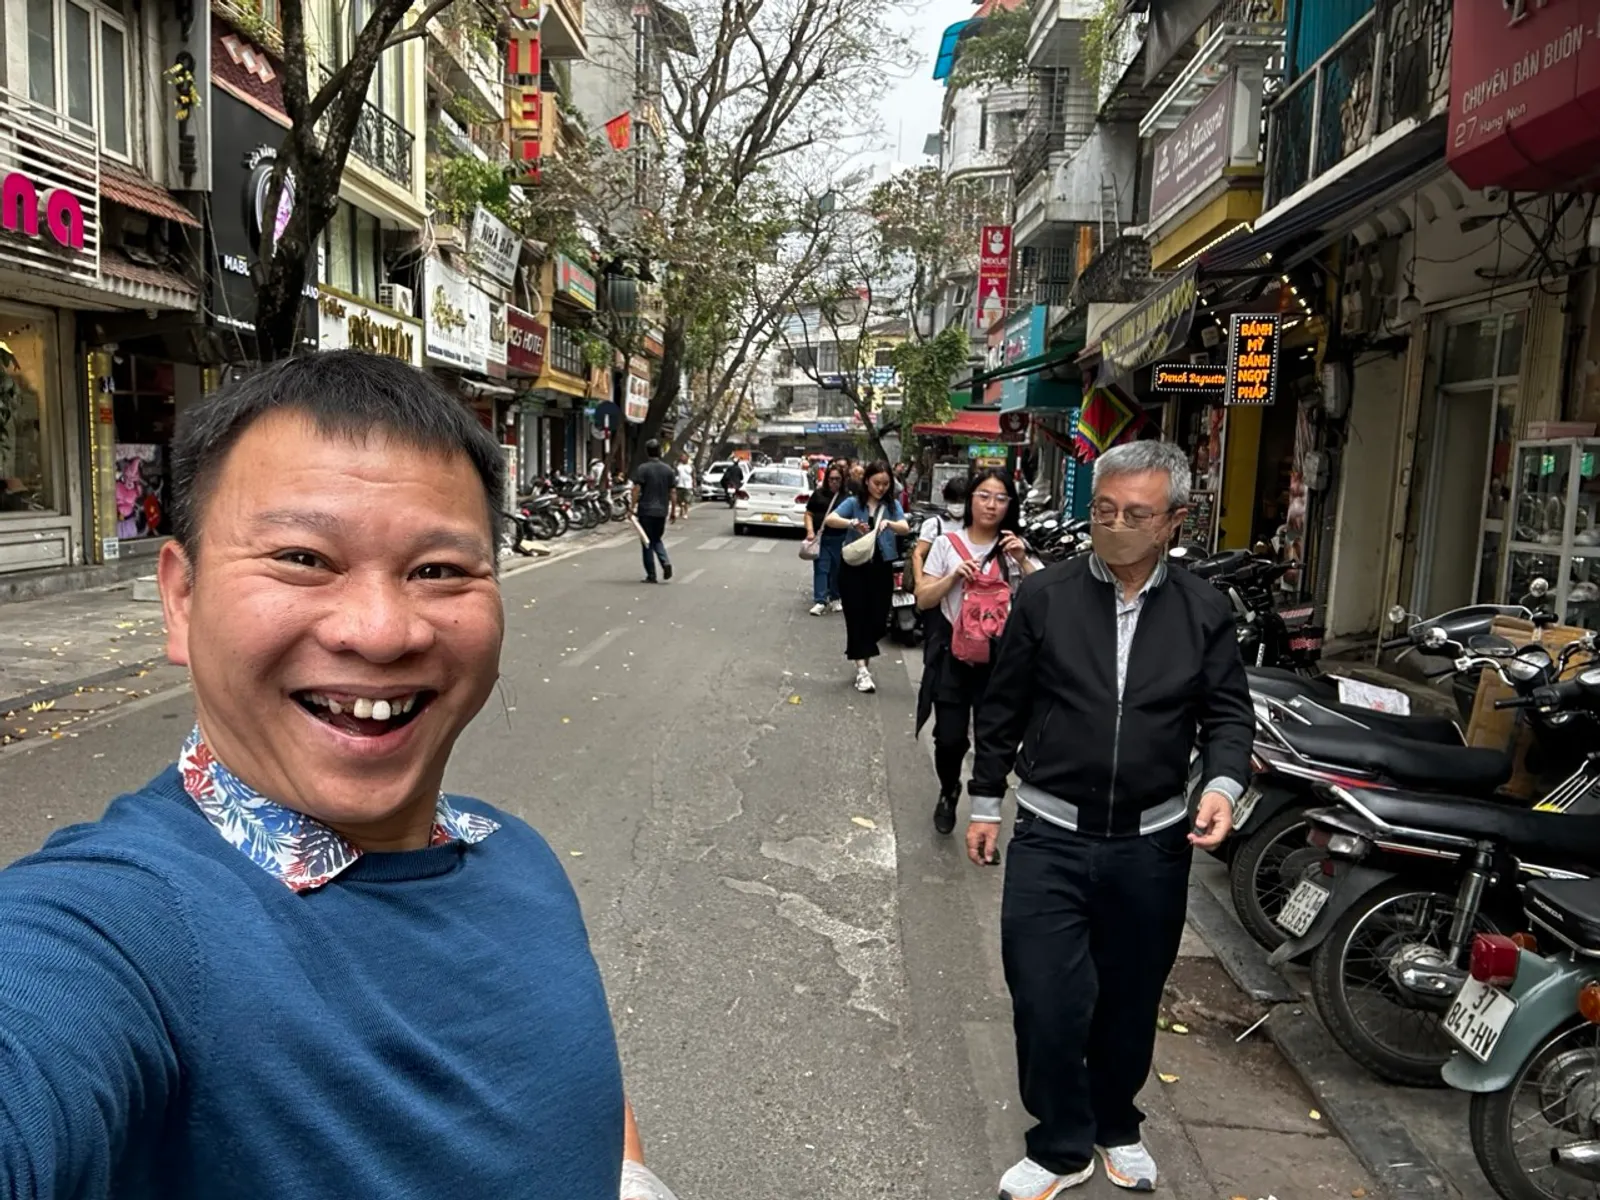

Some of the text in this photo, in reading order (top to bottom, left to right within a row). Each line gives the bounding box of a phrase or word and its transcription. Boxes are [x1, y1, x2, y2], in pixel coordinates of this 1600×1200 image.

[1543, 23, 1583, 69] BUÔN
[1454, 115, 1478, 148] 27
[1241, 320, 1273, 336] BÁNH
[522, 331, 543, 355] HOTEL
[1238, 352, 1271, 367] BÁNH
[1158, 372, 1187, 383] French
[1237, 369, 1270, 386] NGỌT
[1237, 383, 1268, 398] PHÁP
[1472, 985, 1499, 1015] 37
